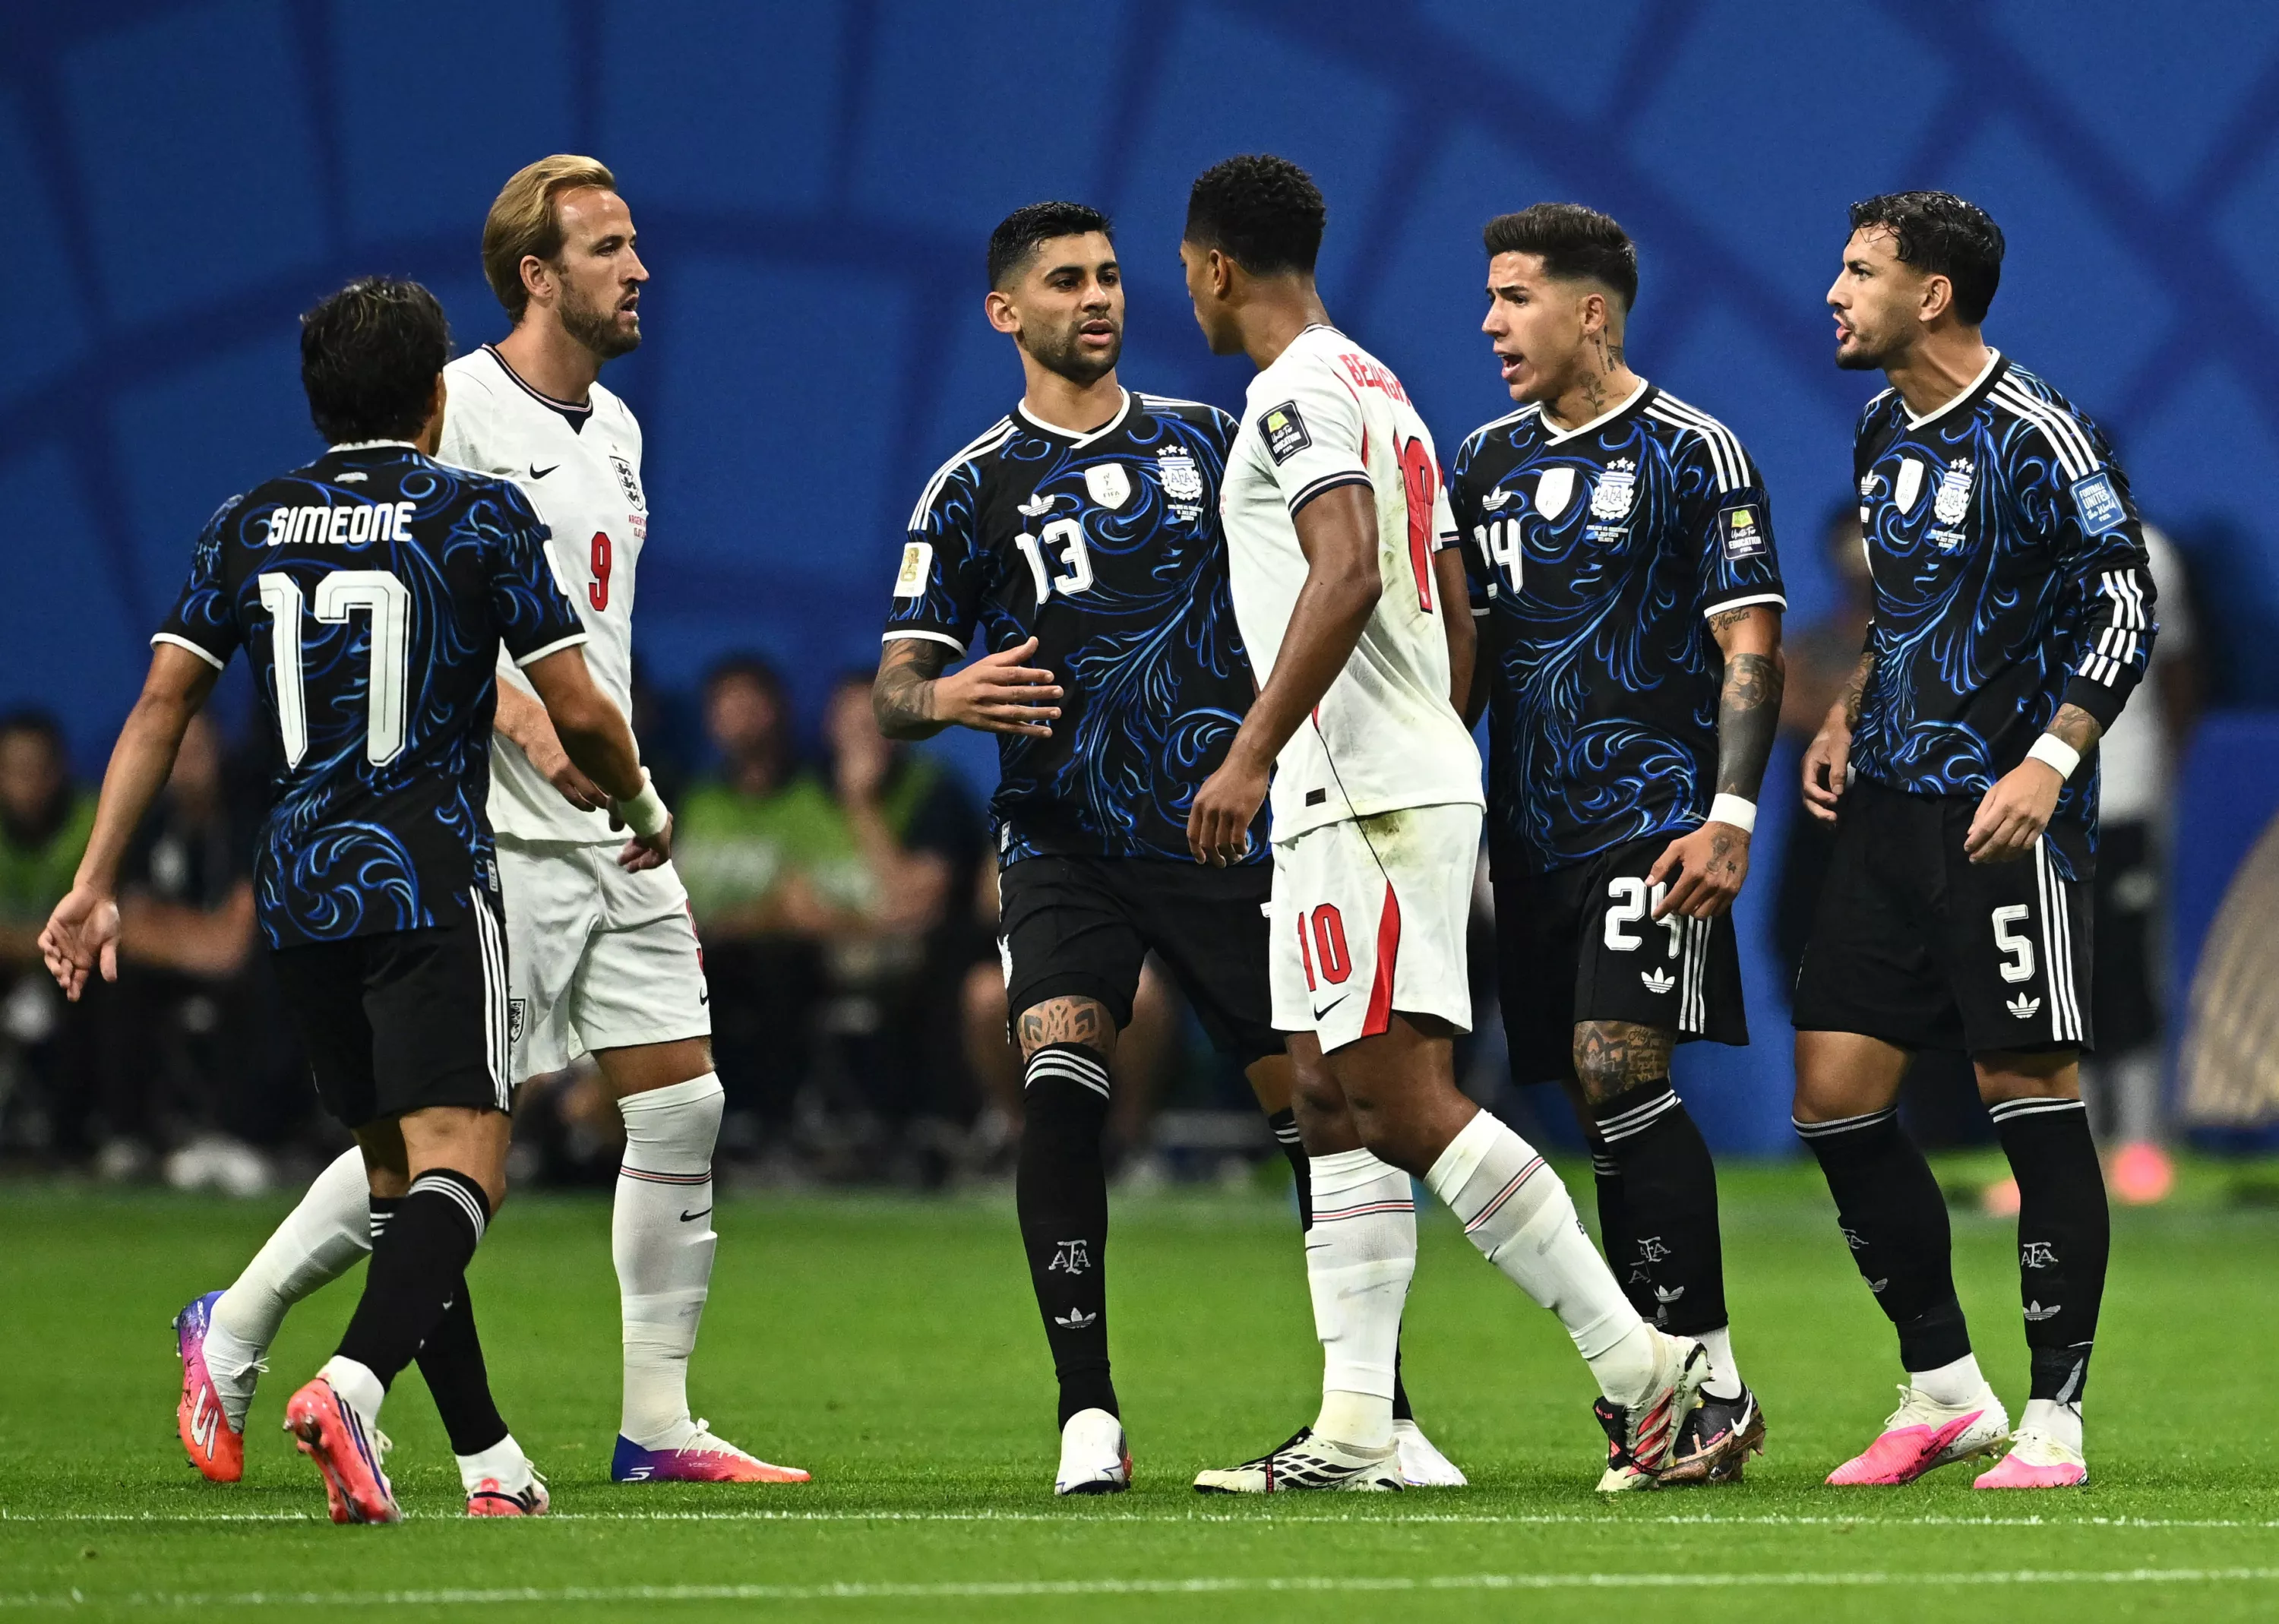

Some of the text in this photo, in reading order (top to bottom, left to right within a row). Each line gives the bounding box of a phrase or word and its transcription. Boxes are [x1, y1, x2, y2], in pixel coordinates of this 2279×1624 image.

[2079, 482, 2105, 499] FOOTBALL
[2082, 489, 2110, 510] UNITES
[2097, 498, 2116, 515] World
[267, 501, 417, 547] SIMEONE
[1728, 536, 1762, 550] EDUCATION
[589, 531, 612, 611] 9
[1014, 517, 1093, 605] 13
[258, 570, 411, 769] 17
[1298, 902, 1352, 992] 10
[1992, 904, 2035, 984] 5
[1048, 1239, 1091, 1275] AFA
[2021, 1241, 2059, 1269] AFA
